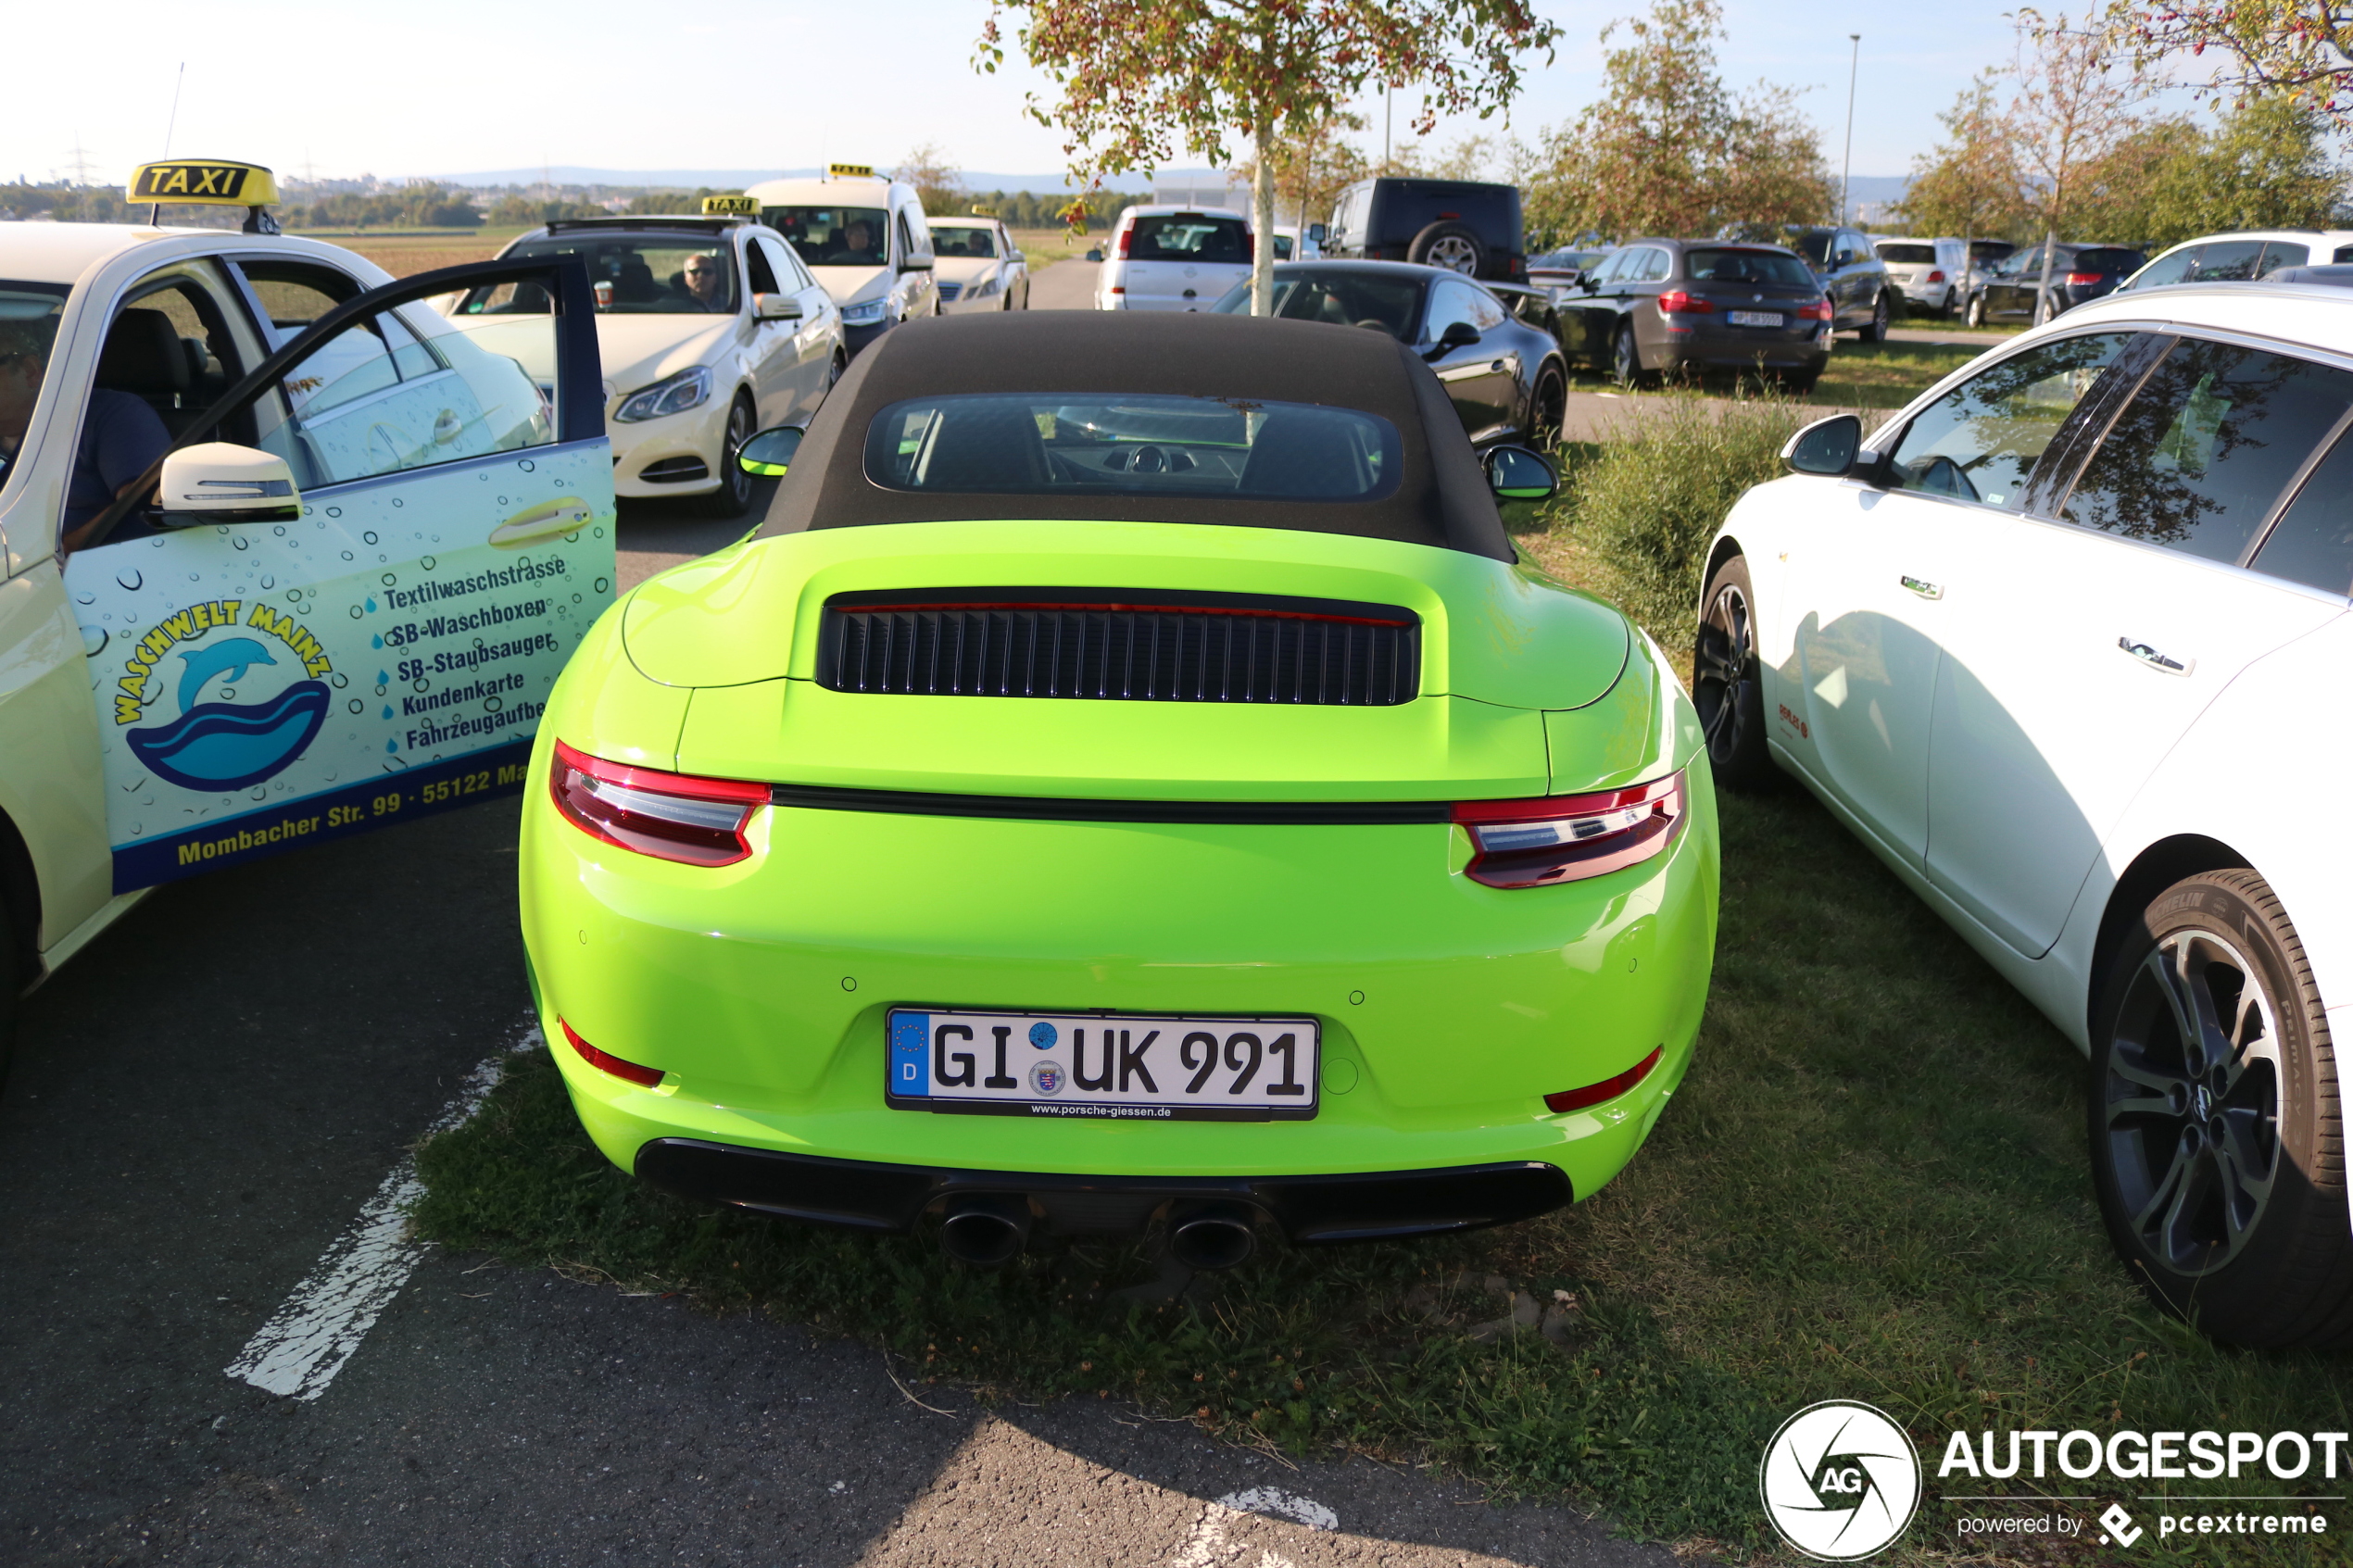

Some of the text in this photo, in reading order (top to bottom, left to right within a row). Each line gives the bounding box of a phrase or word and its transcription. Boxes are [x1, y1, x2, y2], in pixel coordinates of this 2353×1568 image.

[149, 168, 237, 195] TAXI
[833, 165, 866, 174] TAXI
[711, 198, 749, 211] TAXI
[384, 558, 566, 610] Textilwaschstrasse
[392, 597, 547, 647] SB-Waschboxen
[114, 599, 333, 726] WASCHWELT MAINZ
[397, 632, 553, 683] SB-Staubsauger
[402, 672, 524, 717] Kundenkarte
[177, 815, 320, 866] Mombacher
[327, 805, 365, 828] Str.
[372, 792, 401, 817] 99
[422, 771, 490, 804] 55122
[902, 1062, 917, 1081] D
[933, 1023, 1018, 1089] GI
[1072, 1027, 1161, 1094] UK
[1179, 1031, 1305, 1096] 991
[2281, 999, 2302, 1117] PRIMACY
[1031, 1105, 1171, 1118] www.porsche-giessen.de
